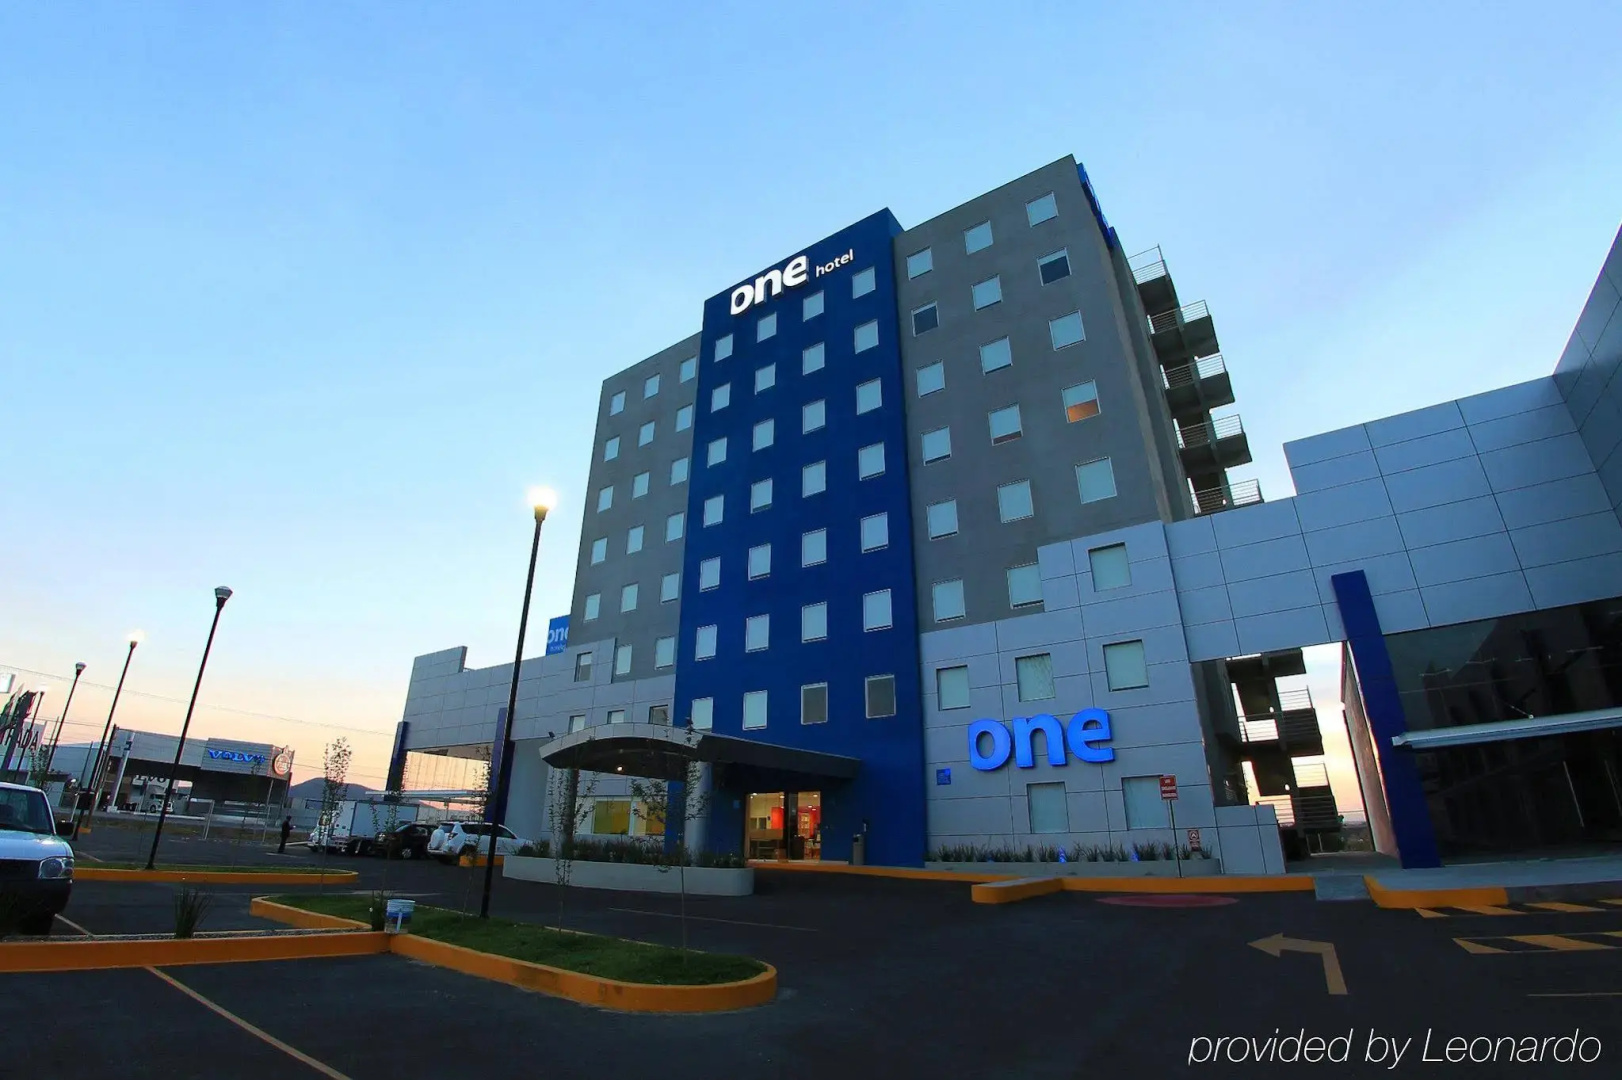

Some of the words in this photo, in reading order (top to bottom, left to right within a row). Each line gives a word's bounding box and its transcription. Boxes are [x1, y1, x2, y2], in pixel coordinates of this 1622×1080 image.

[730, 255, 809, 316] one
[815, 248, 854, 278] hotel
[967, 707, 1116, 772] one
